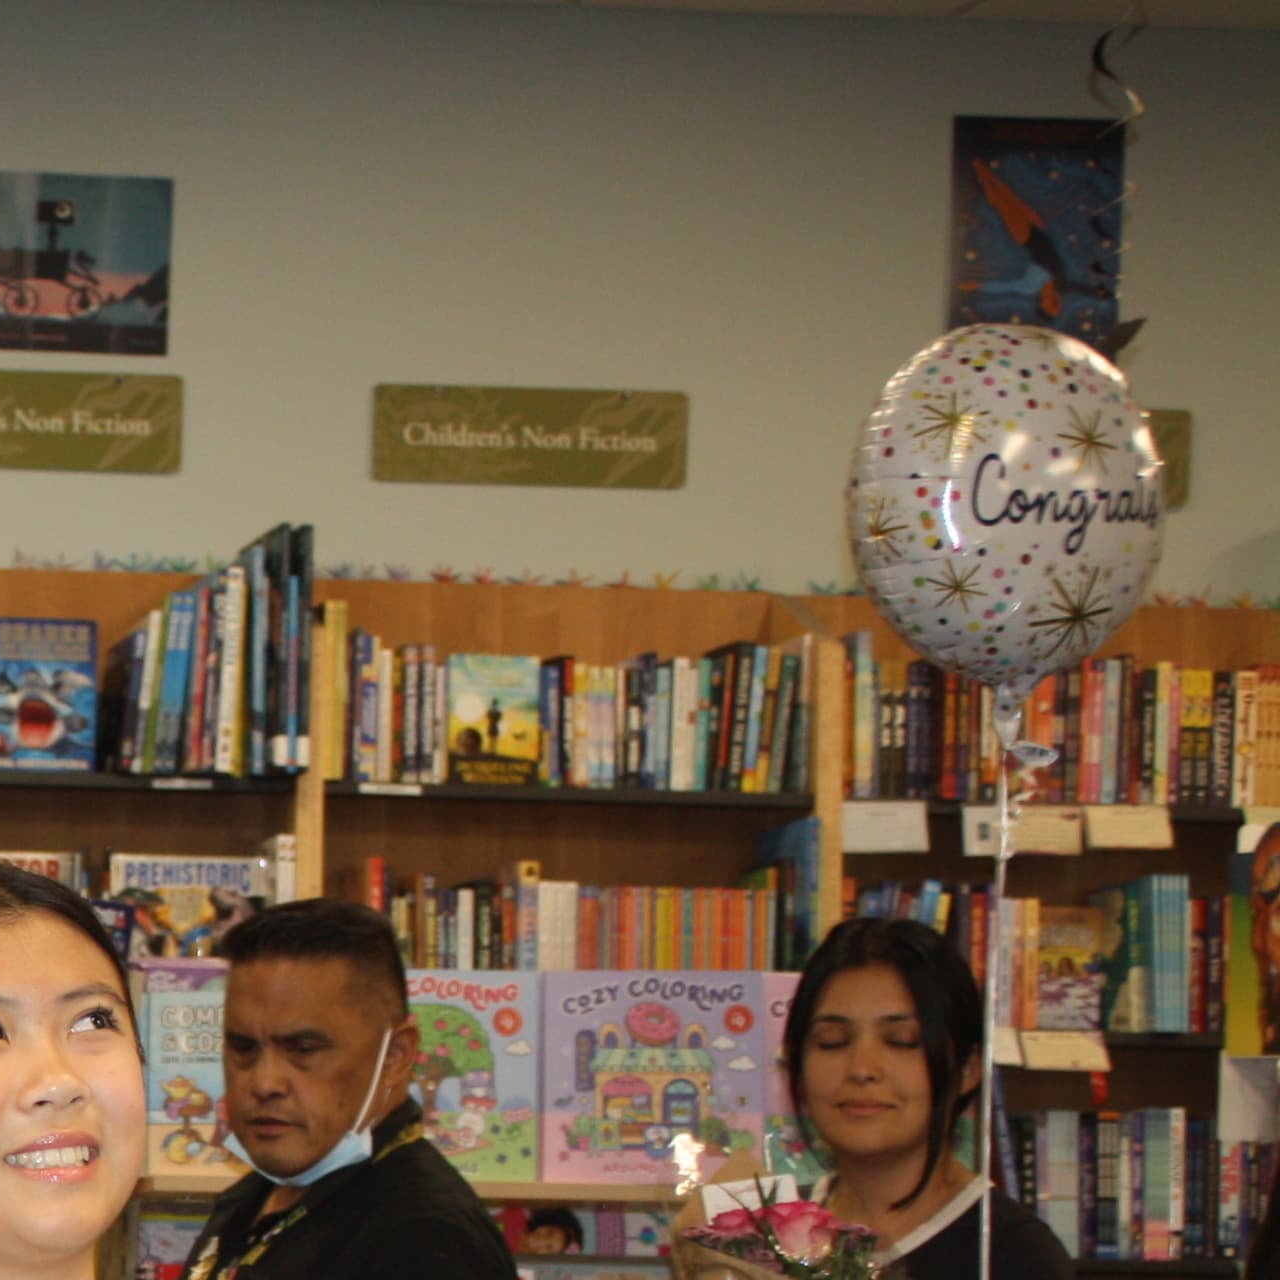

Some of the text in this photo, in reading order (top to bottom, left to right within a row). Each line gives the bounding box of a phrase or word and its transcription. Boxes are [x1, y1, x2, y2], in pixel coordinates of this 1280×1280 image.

[13, 408, 66, 434] Non
[71, 410, 153, 437] Fiction
[402, 423, 659, 453] Children's Non Fiction
[125, 861, 251, 893] PREHISTORIC
[407, 977, 520, 1011] COLORING
[562, 984, 619, 1016] COZY
[627, 977, 746, 1011] COLORING
